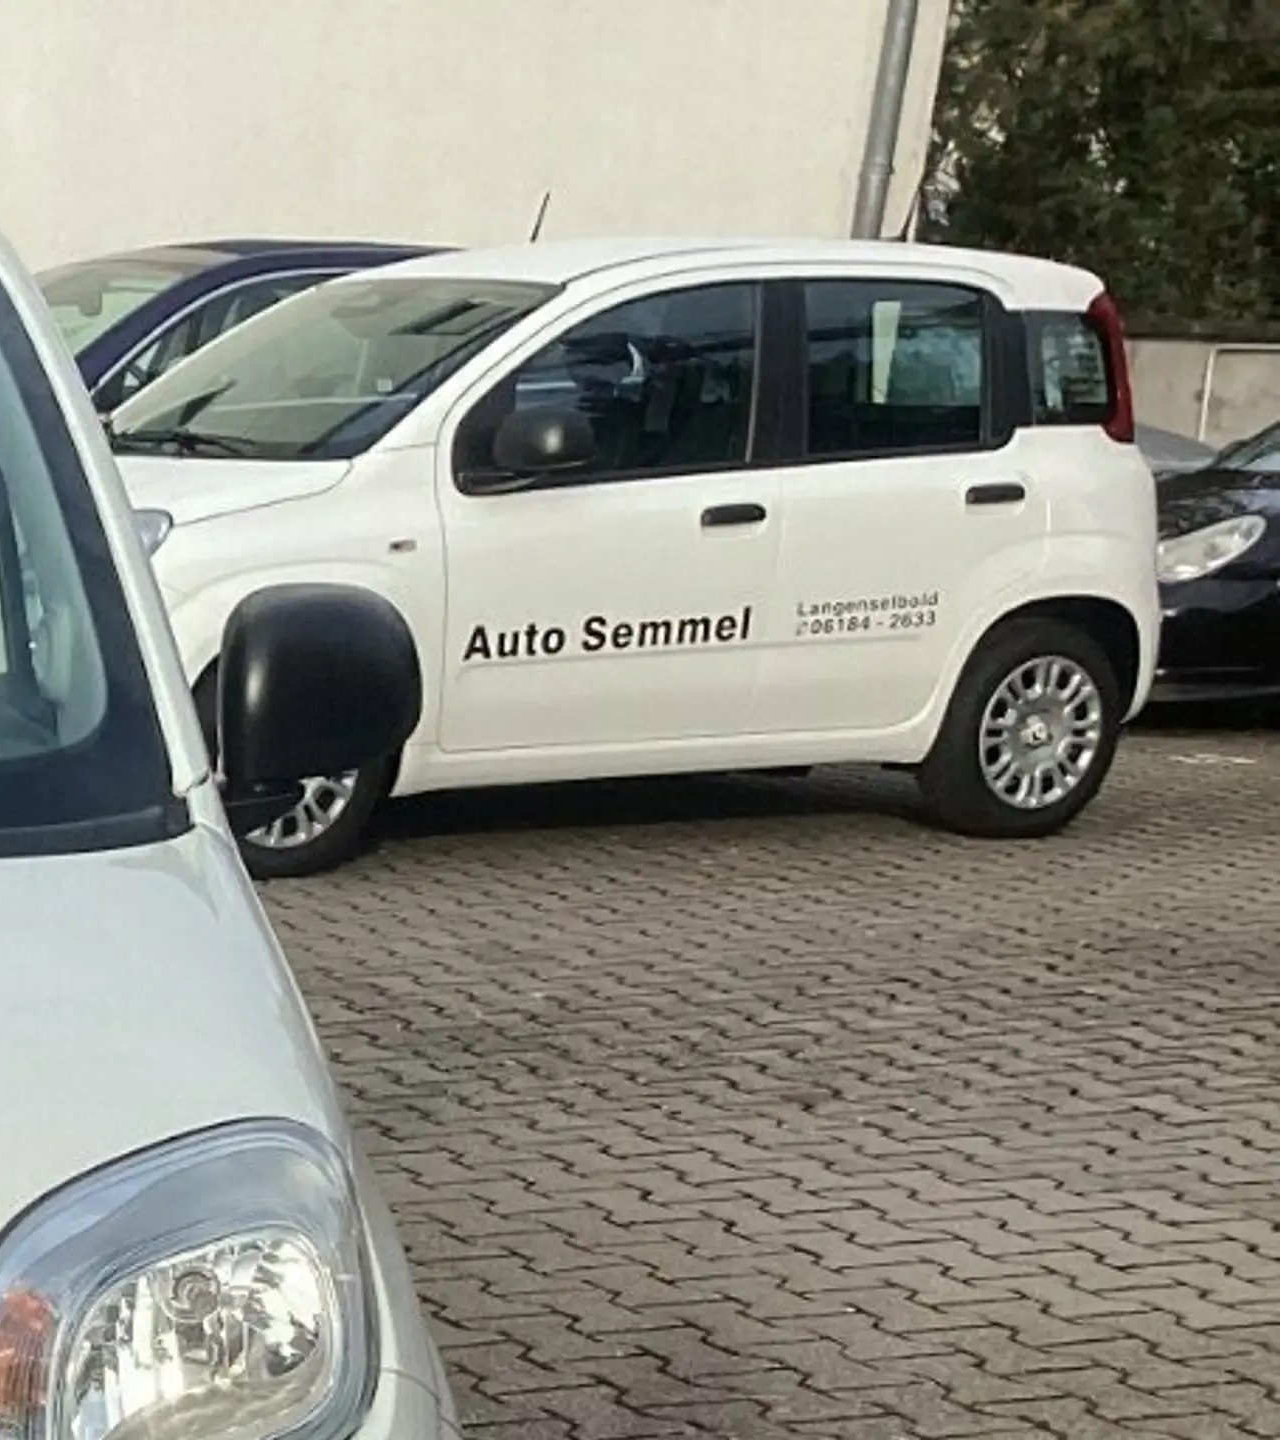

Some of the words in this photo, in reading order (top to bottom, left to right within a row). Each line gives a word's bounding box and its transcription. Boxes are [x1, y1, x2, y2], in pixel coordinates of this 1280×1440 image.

[796, 591, 939, 617] Langenselbold
[462, 624, 566, 661] Auto
[581, 606, 751, 652] Semmel
